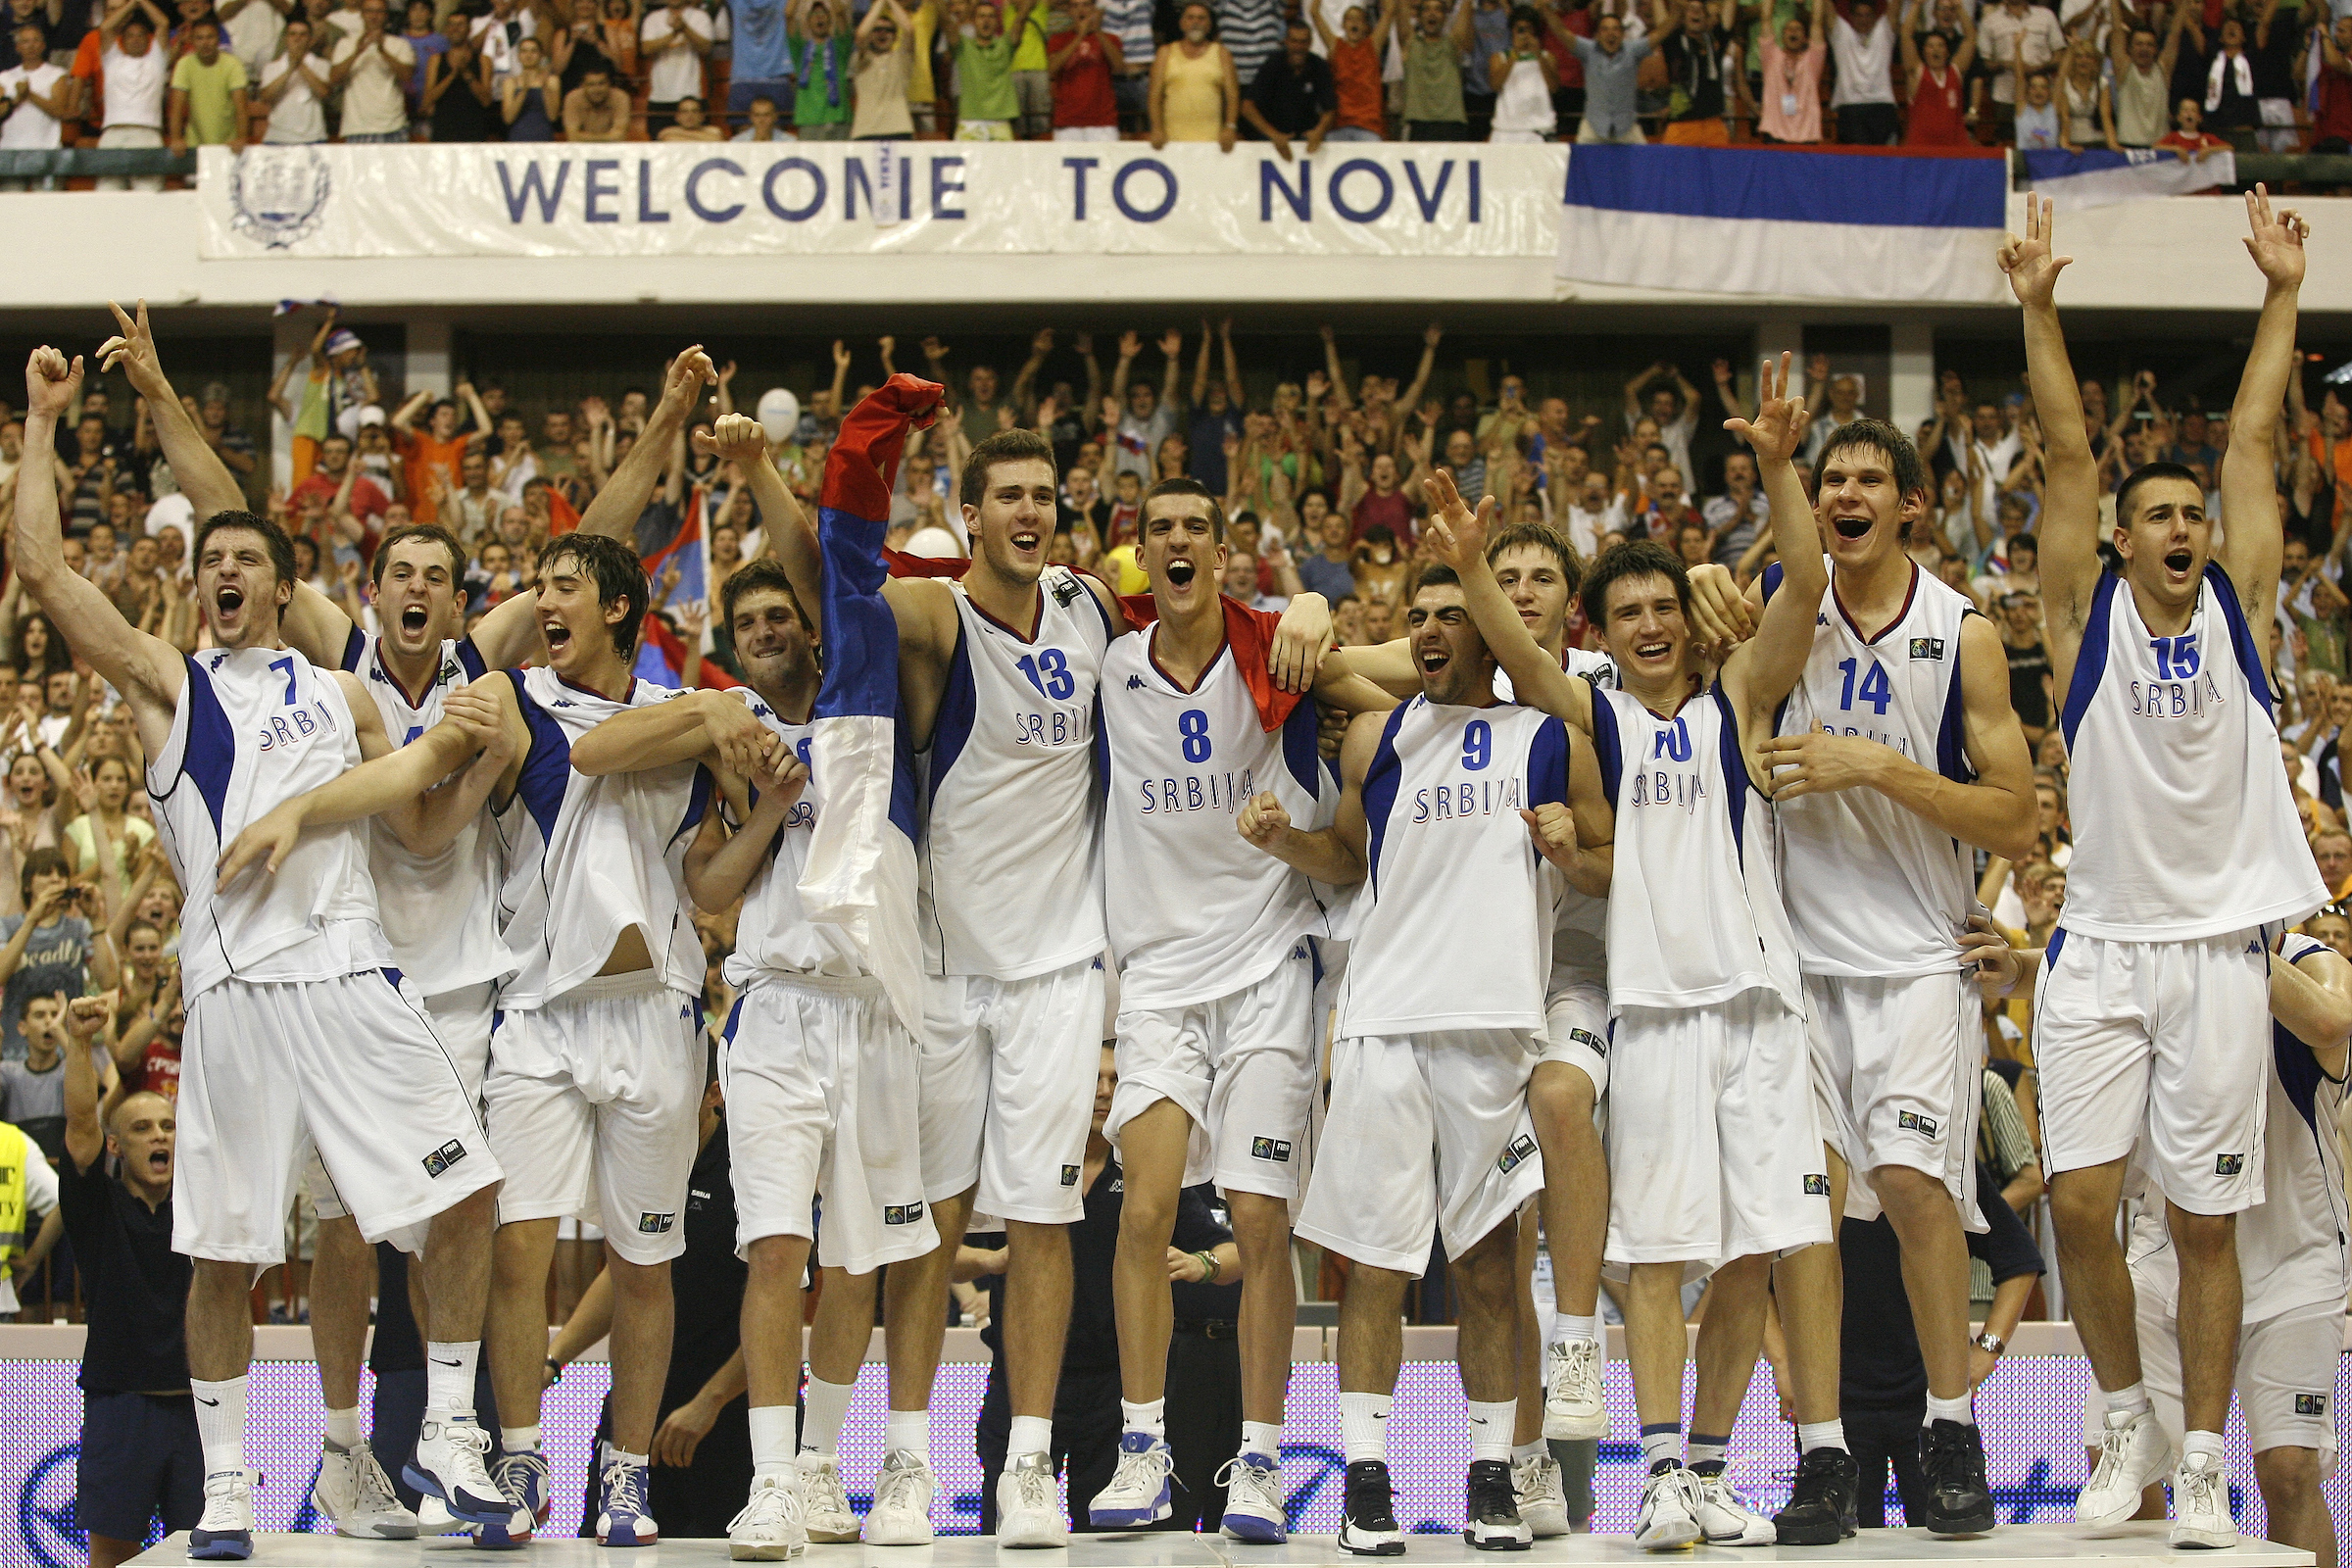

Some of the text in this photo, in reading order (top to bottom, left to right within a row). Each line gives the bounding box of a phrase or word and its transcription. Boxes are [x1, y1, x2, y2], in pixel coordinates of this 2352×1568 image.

[495, 156, 966, 223] WELCOME
[1063, 158, 1179, 223] TO
[1259, 158, 1481, 223] NOVI
[269, 656, 297, 706] 7
[1015, 648, 1075, 701] 13
[2150, 633, 2200, 680] 15
[1838, 657, 1891, 715] 14
[1178, 709, 1212, 763] 8
[1461, 719, 1492, 771] 9
[1655, 716, 1692, 762] 10
[1140, 768, 1256, 814] SRBIJA
[1412, 777, 1523, 824] SRBIJA
[443, 1141, 460, 1155] FIBA
